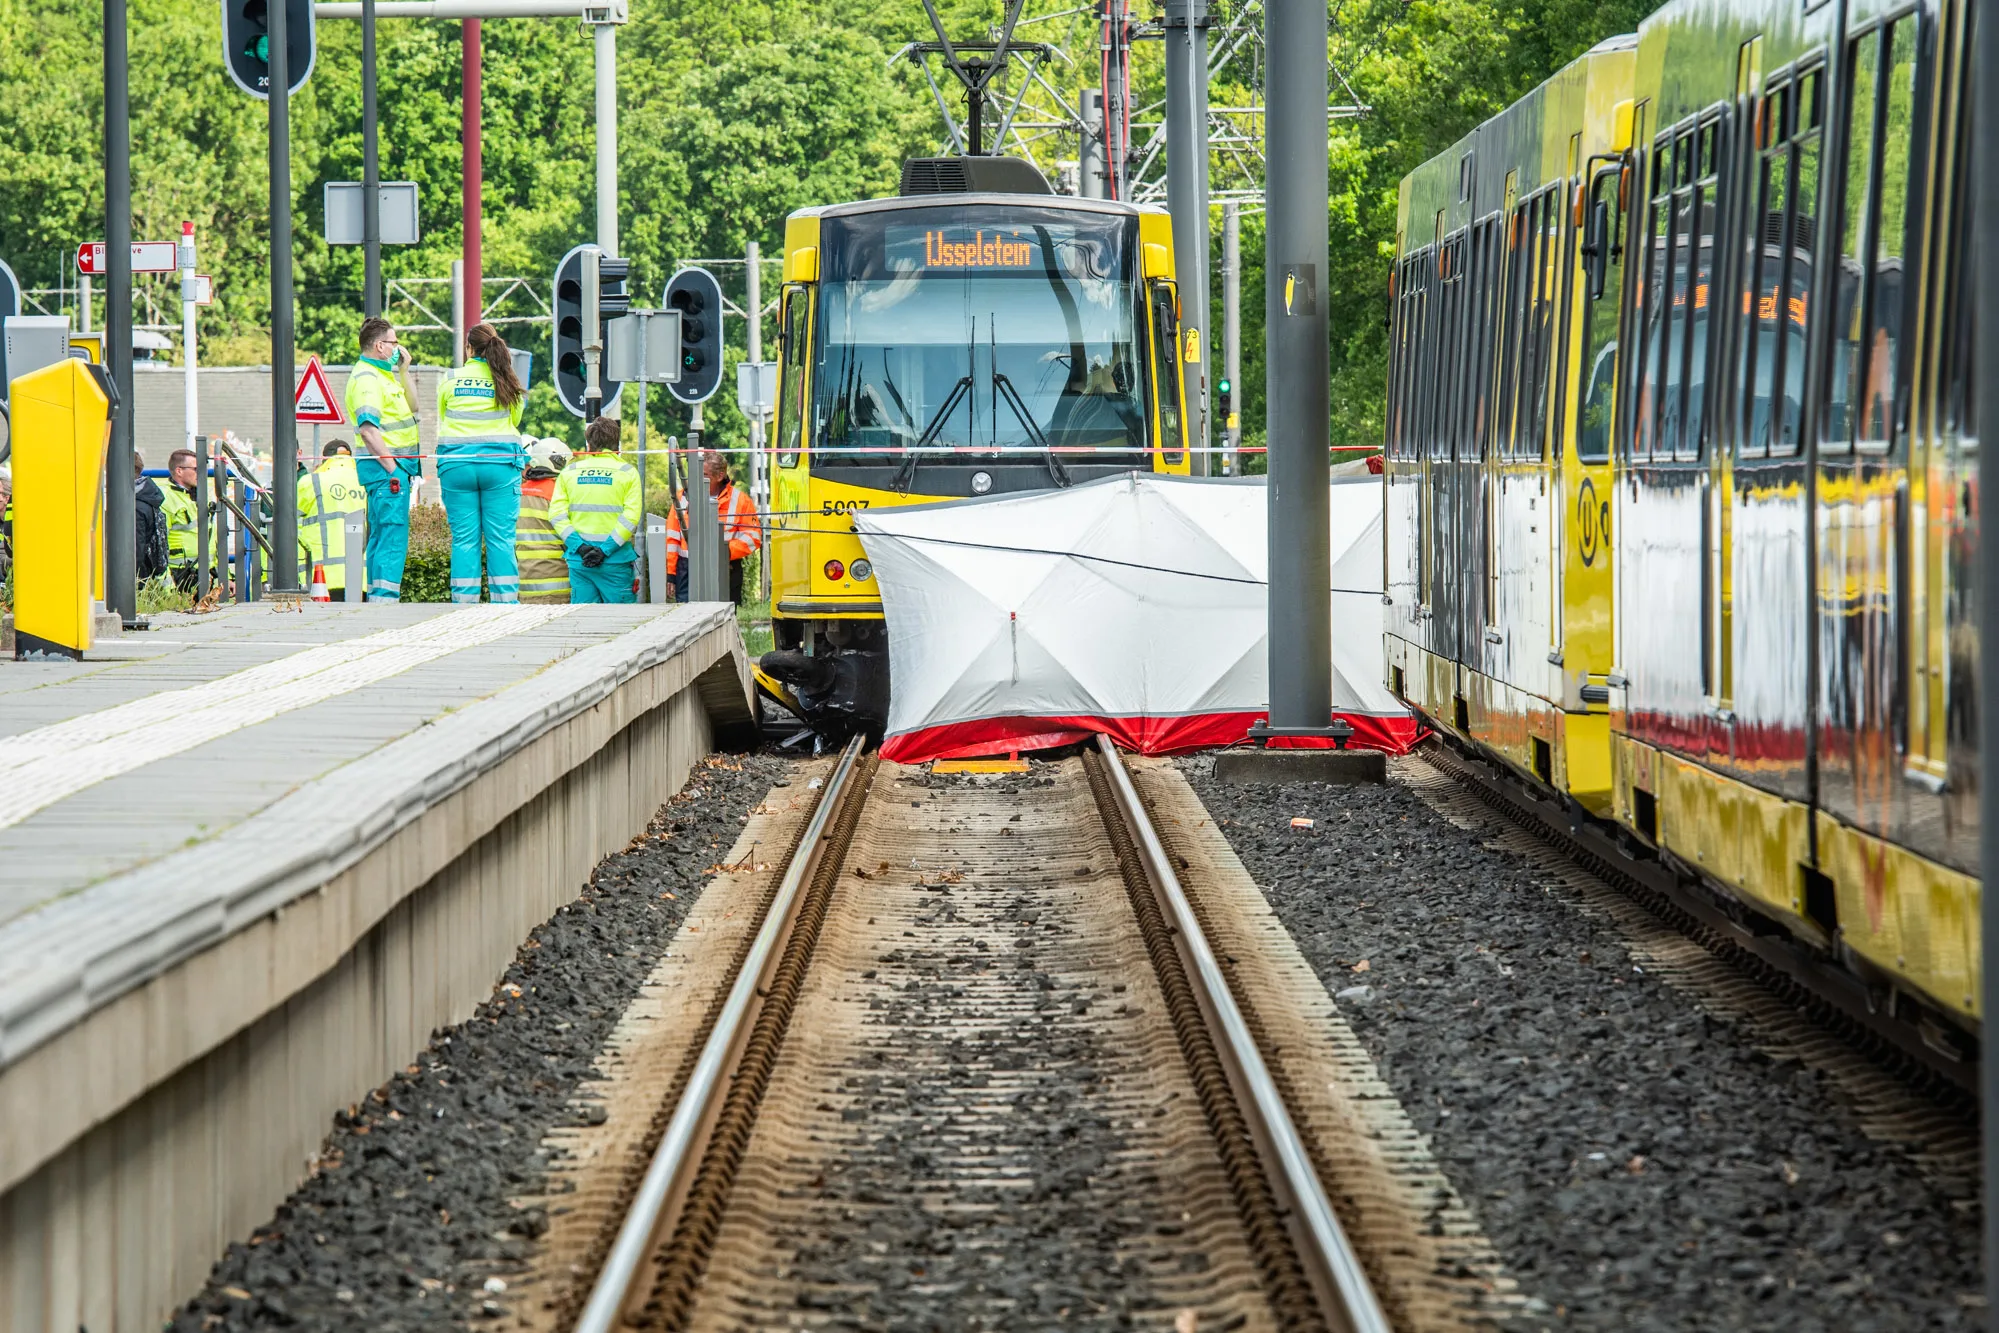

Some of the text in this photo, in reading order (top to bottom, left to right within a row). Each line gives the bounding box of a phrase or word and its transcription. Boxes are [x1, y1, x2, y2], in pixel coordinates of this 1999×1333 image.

[926, 230, 1031, 267] IJsselstein
[455, 387, 493, 397] AMBULANCE
[578, 476, 612, 485] AMBULANCE
